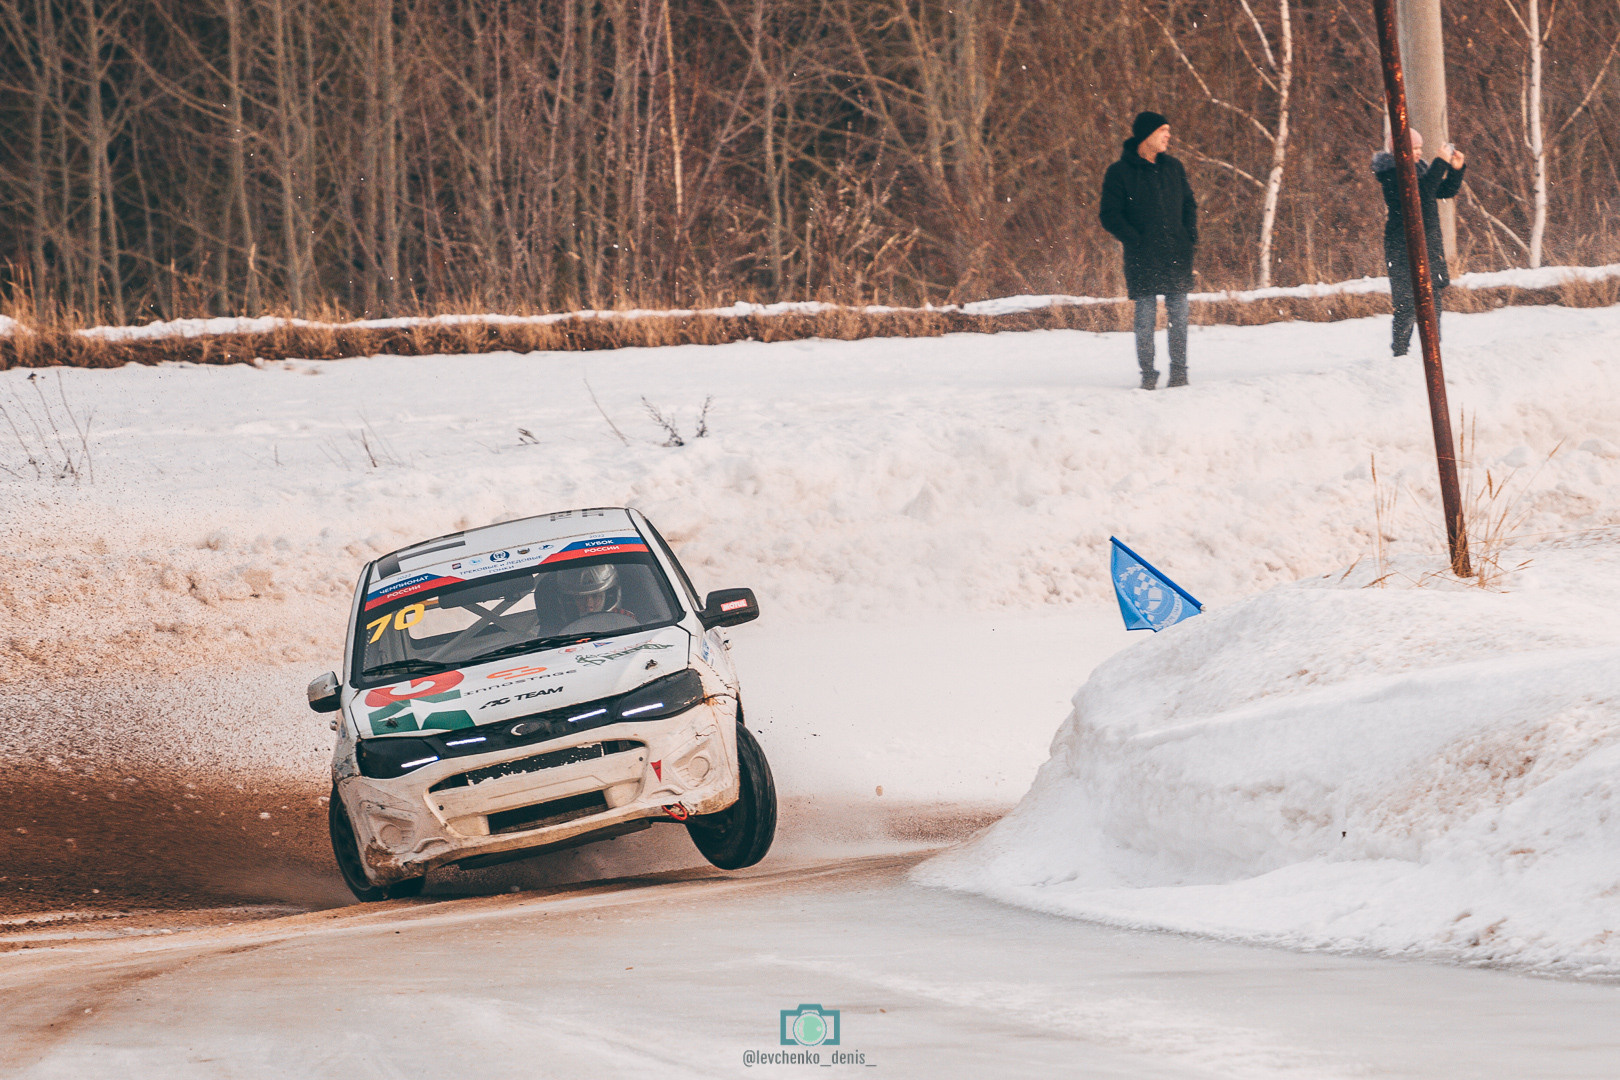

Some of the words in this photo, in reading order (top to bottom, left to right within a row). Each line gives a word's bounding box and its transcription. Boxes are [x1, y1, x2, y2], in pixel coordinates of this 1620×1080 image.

[583, 545, 620, 554] РОССИИ
[584, 539, 614, 547] КУБОК
[379, 575, 429, 594] ЧЕМПИОНАТ
[386, 584, 421, 598] РОССИИ
[721, 599, 747, 611] MOTUL
[366, 603, 425, 645] 70
[514, 686, 564, 701] TEAM
